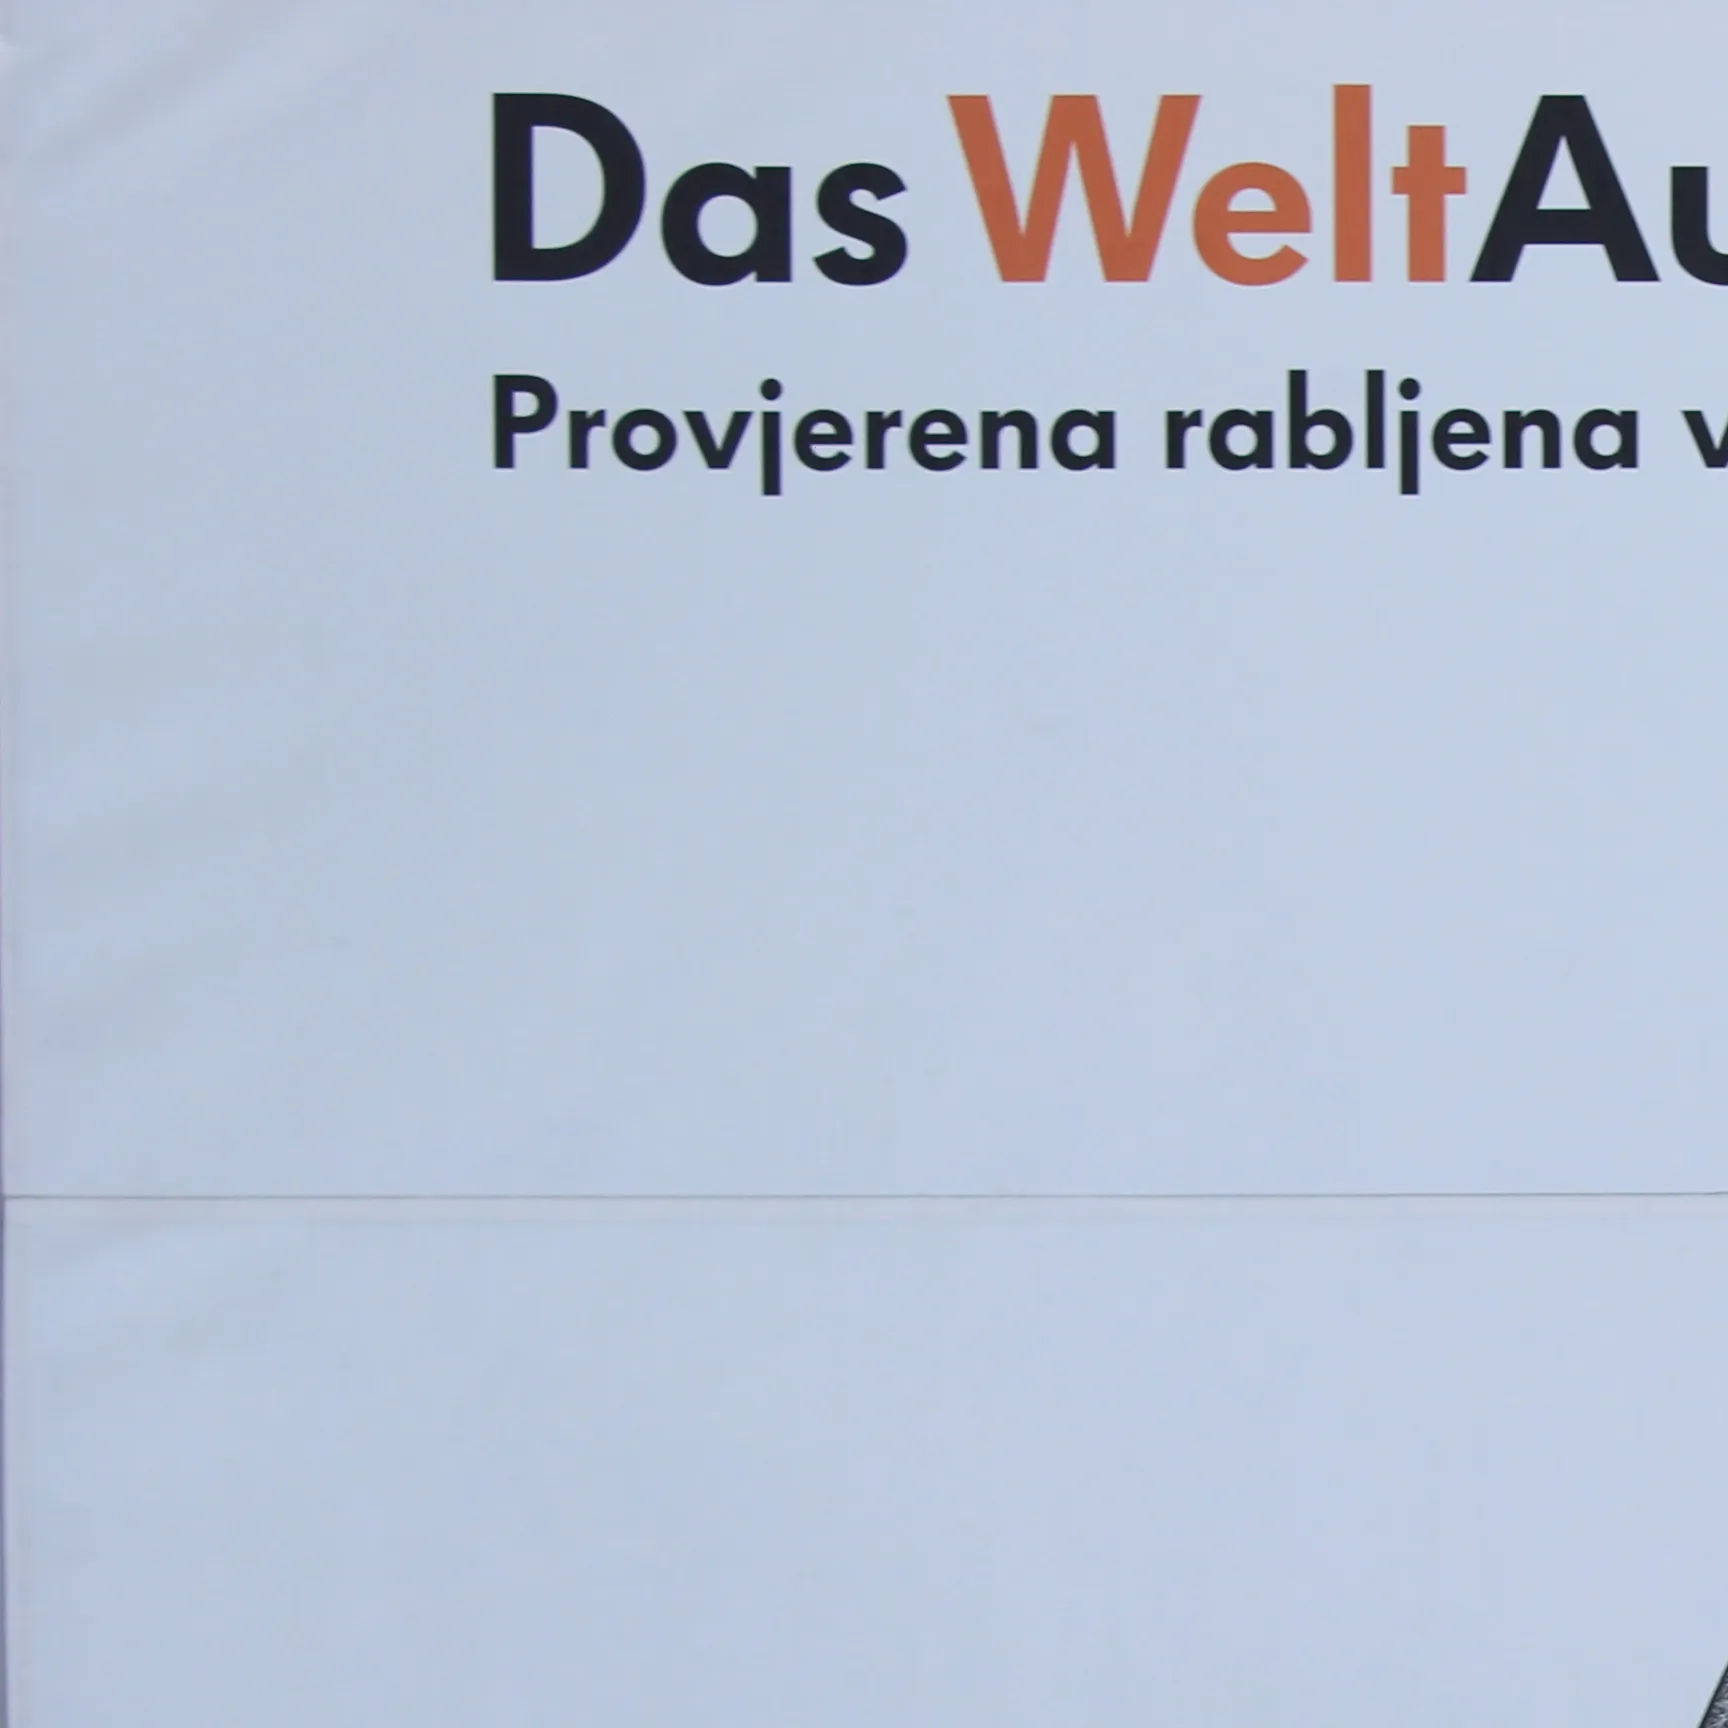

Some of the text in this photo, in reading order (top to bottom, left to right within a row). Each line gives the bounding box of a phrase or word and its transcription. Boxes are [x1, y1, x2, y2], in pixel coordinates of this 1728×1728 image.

[491, 90, 909, 288] Das
[491, 372, 1118, 498] Provjerena
[1164, 368, 1640, 497] rabljena
